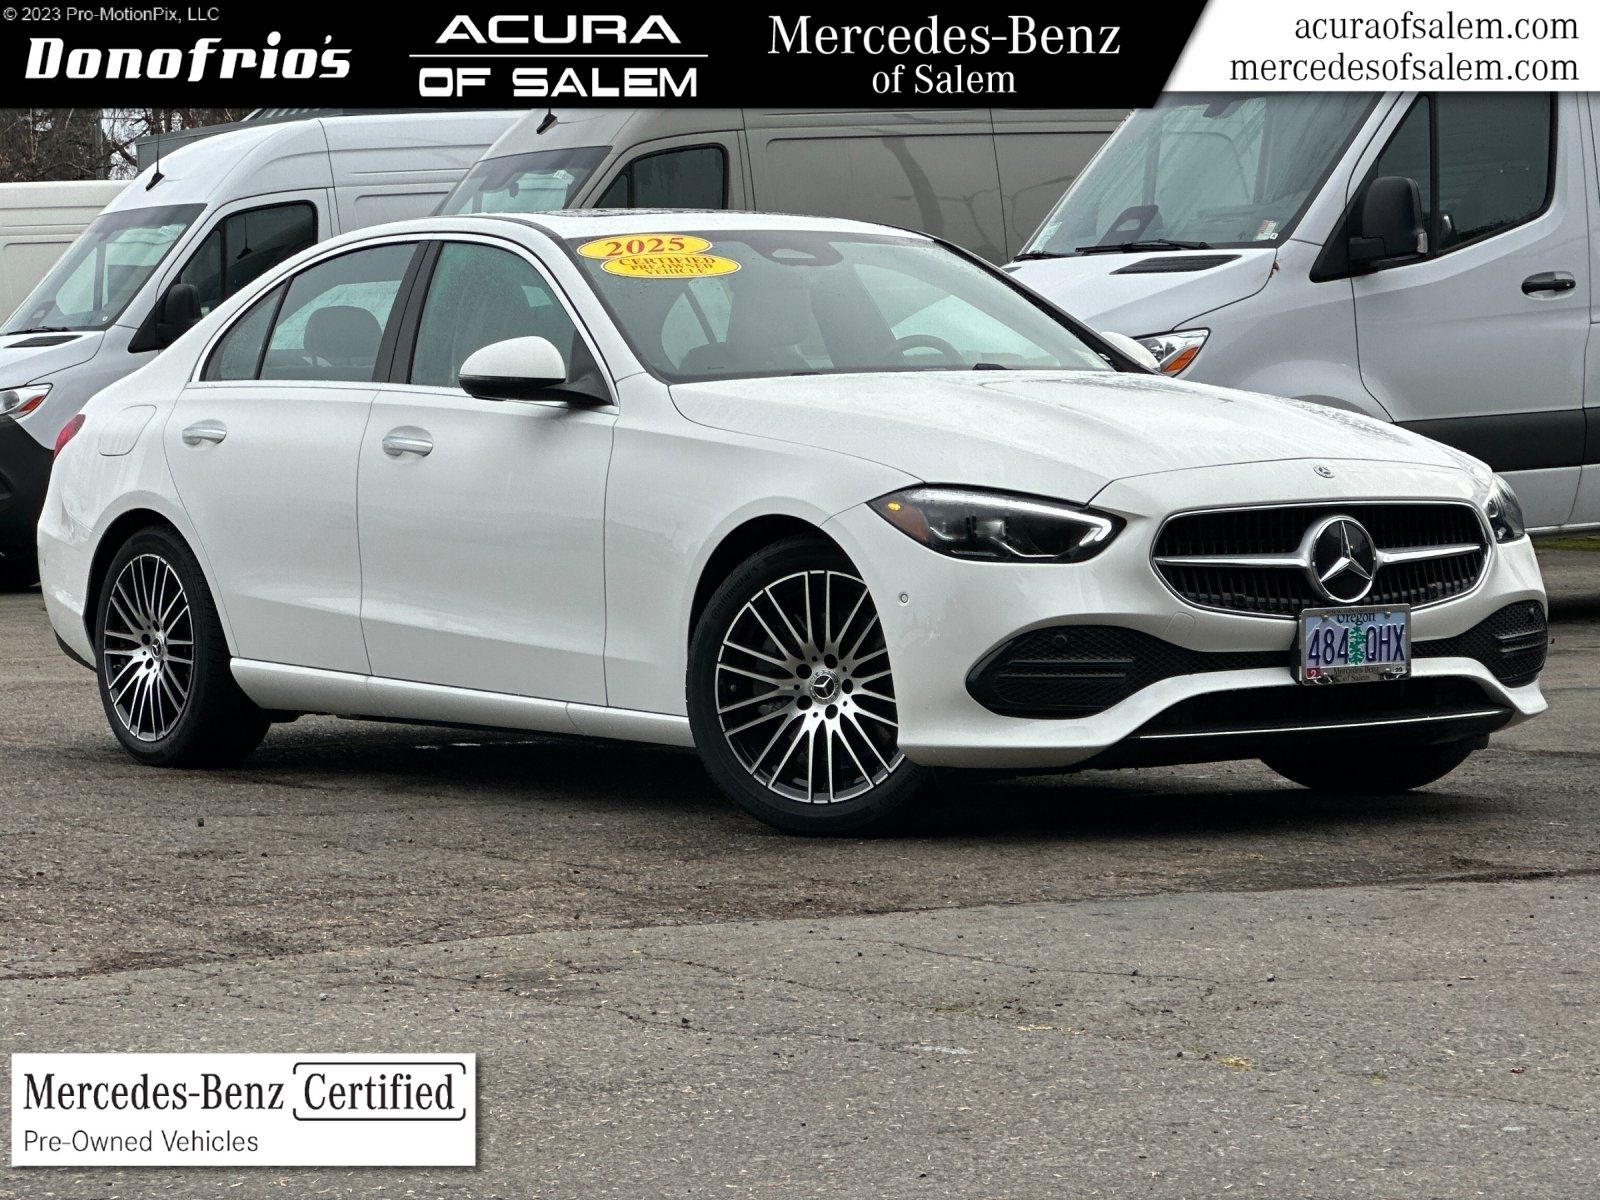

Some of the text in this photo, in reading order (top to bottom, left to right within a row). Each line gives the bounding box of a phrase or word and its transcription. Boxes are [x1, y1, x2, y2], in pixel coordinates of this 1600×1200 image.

[605, 238, 685, 256] 2025
[620, 257, 715, 265] CERTIFIED
[630, 263, 714, 271] PRE-OWNED
[1336, 612, 1377, 625] Oregon
[1309, 627, 1349, 665] 484
